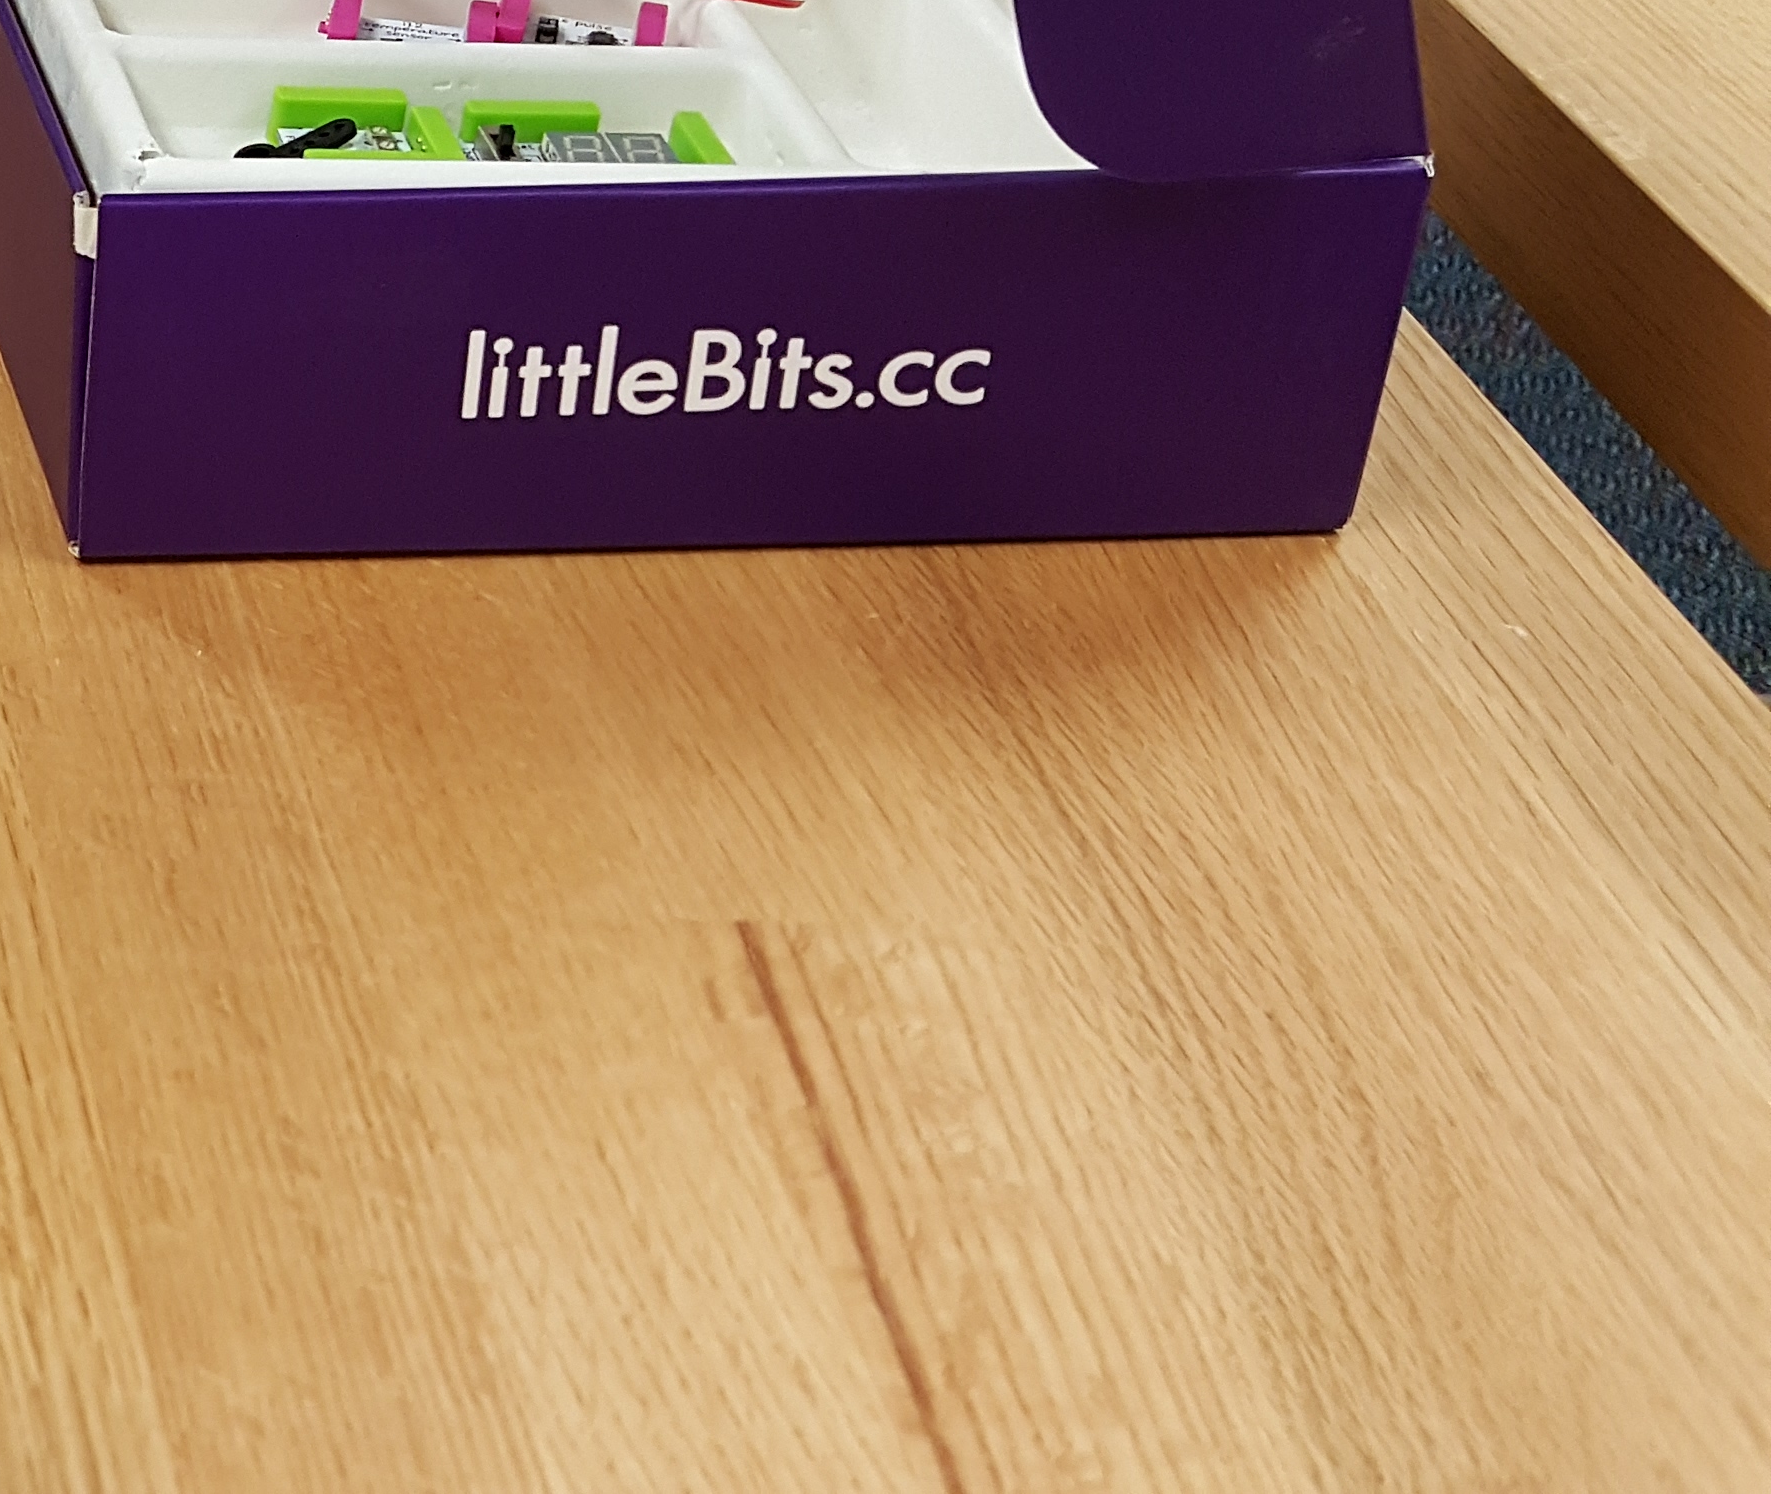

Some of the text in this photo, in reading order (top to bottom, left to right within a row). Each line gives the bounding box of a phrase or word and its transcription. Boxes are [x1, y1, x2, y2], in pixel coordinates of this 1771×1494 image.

[363, 22, 461, 37] temperature
[574, 20, 612, 31] pulse
[386, 30, 433, 40] sensor
[461, 324, 991, 420] littleBits.cc
